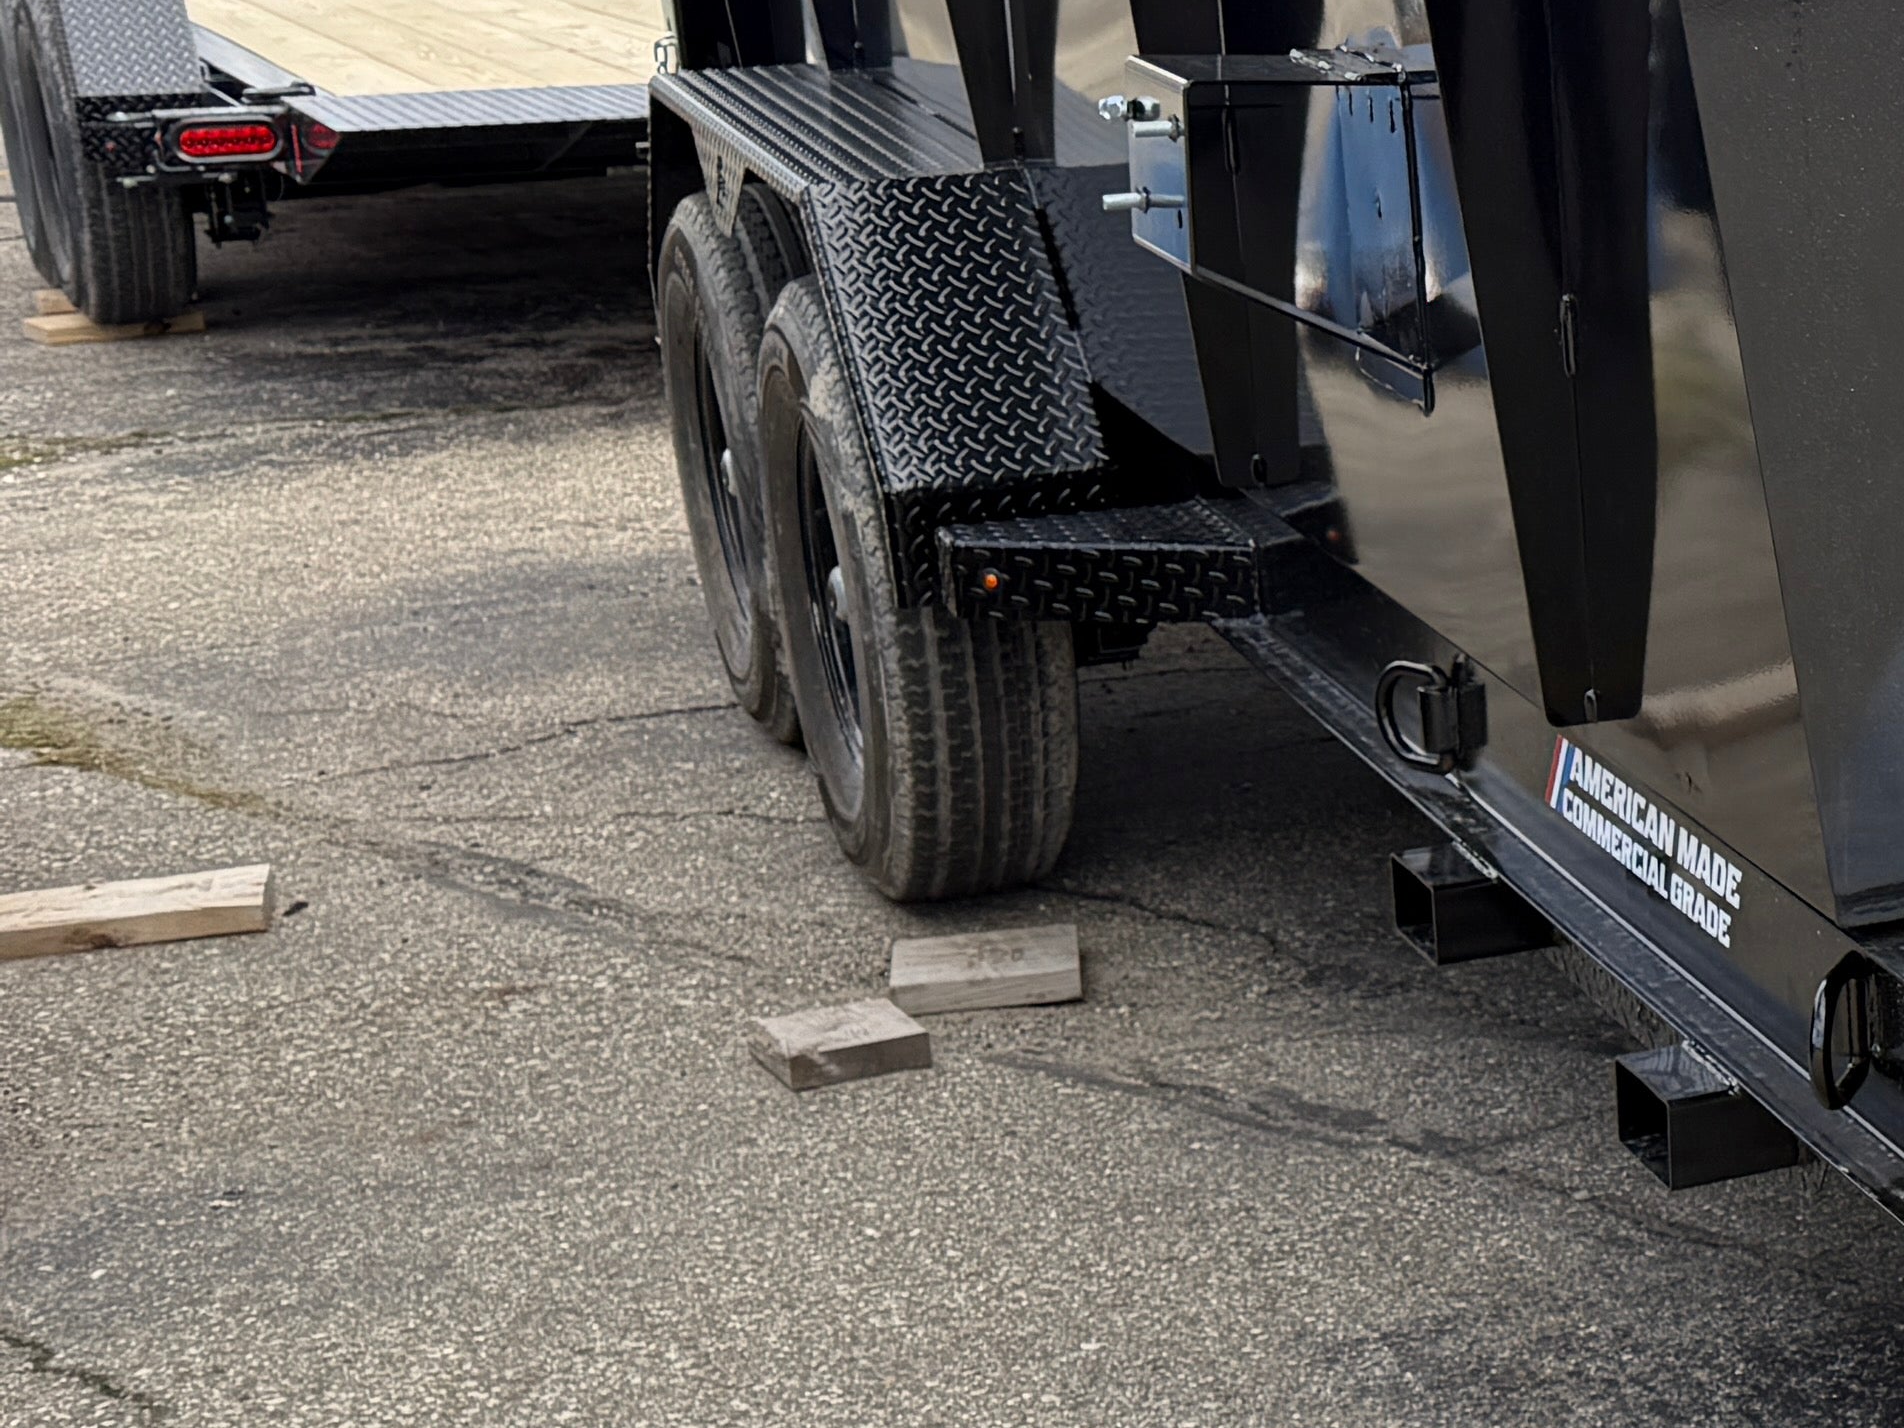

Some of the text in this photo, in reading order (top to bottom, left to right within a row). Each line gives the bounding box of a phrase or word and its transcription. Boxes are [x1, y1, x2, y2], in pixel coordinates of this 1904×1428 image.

[1562, 788, 1732, 949] COMMERCIAL GRADE
[1569, 747, 1742, 910] AMERICAN MADE
